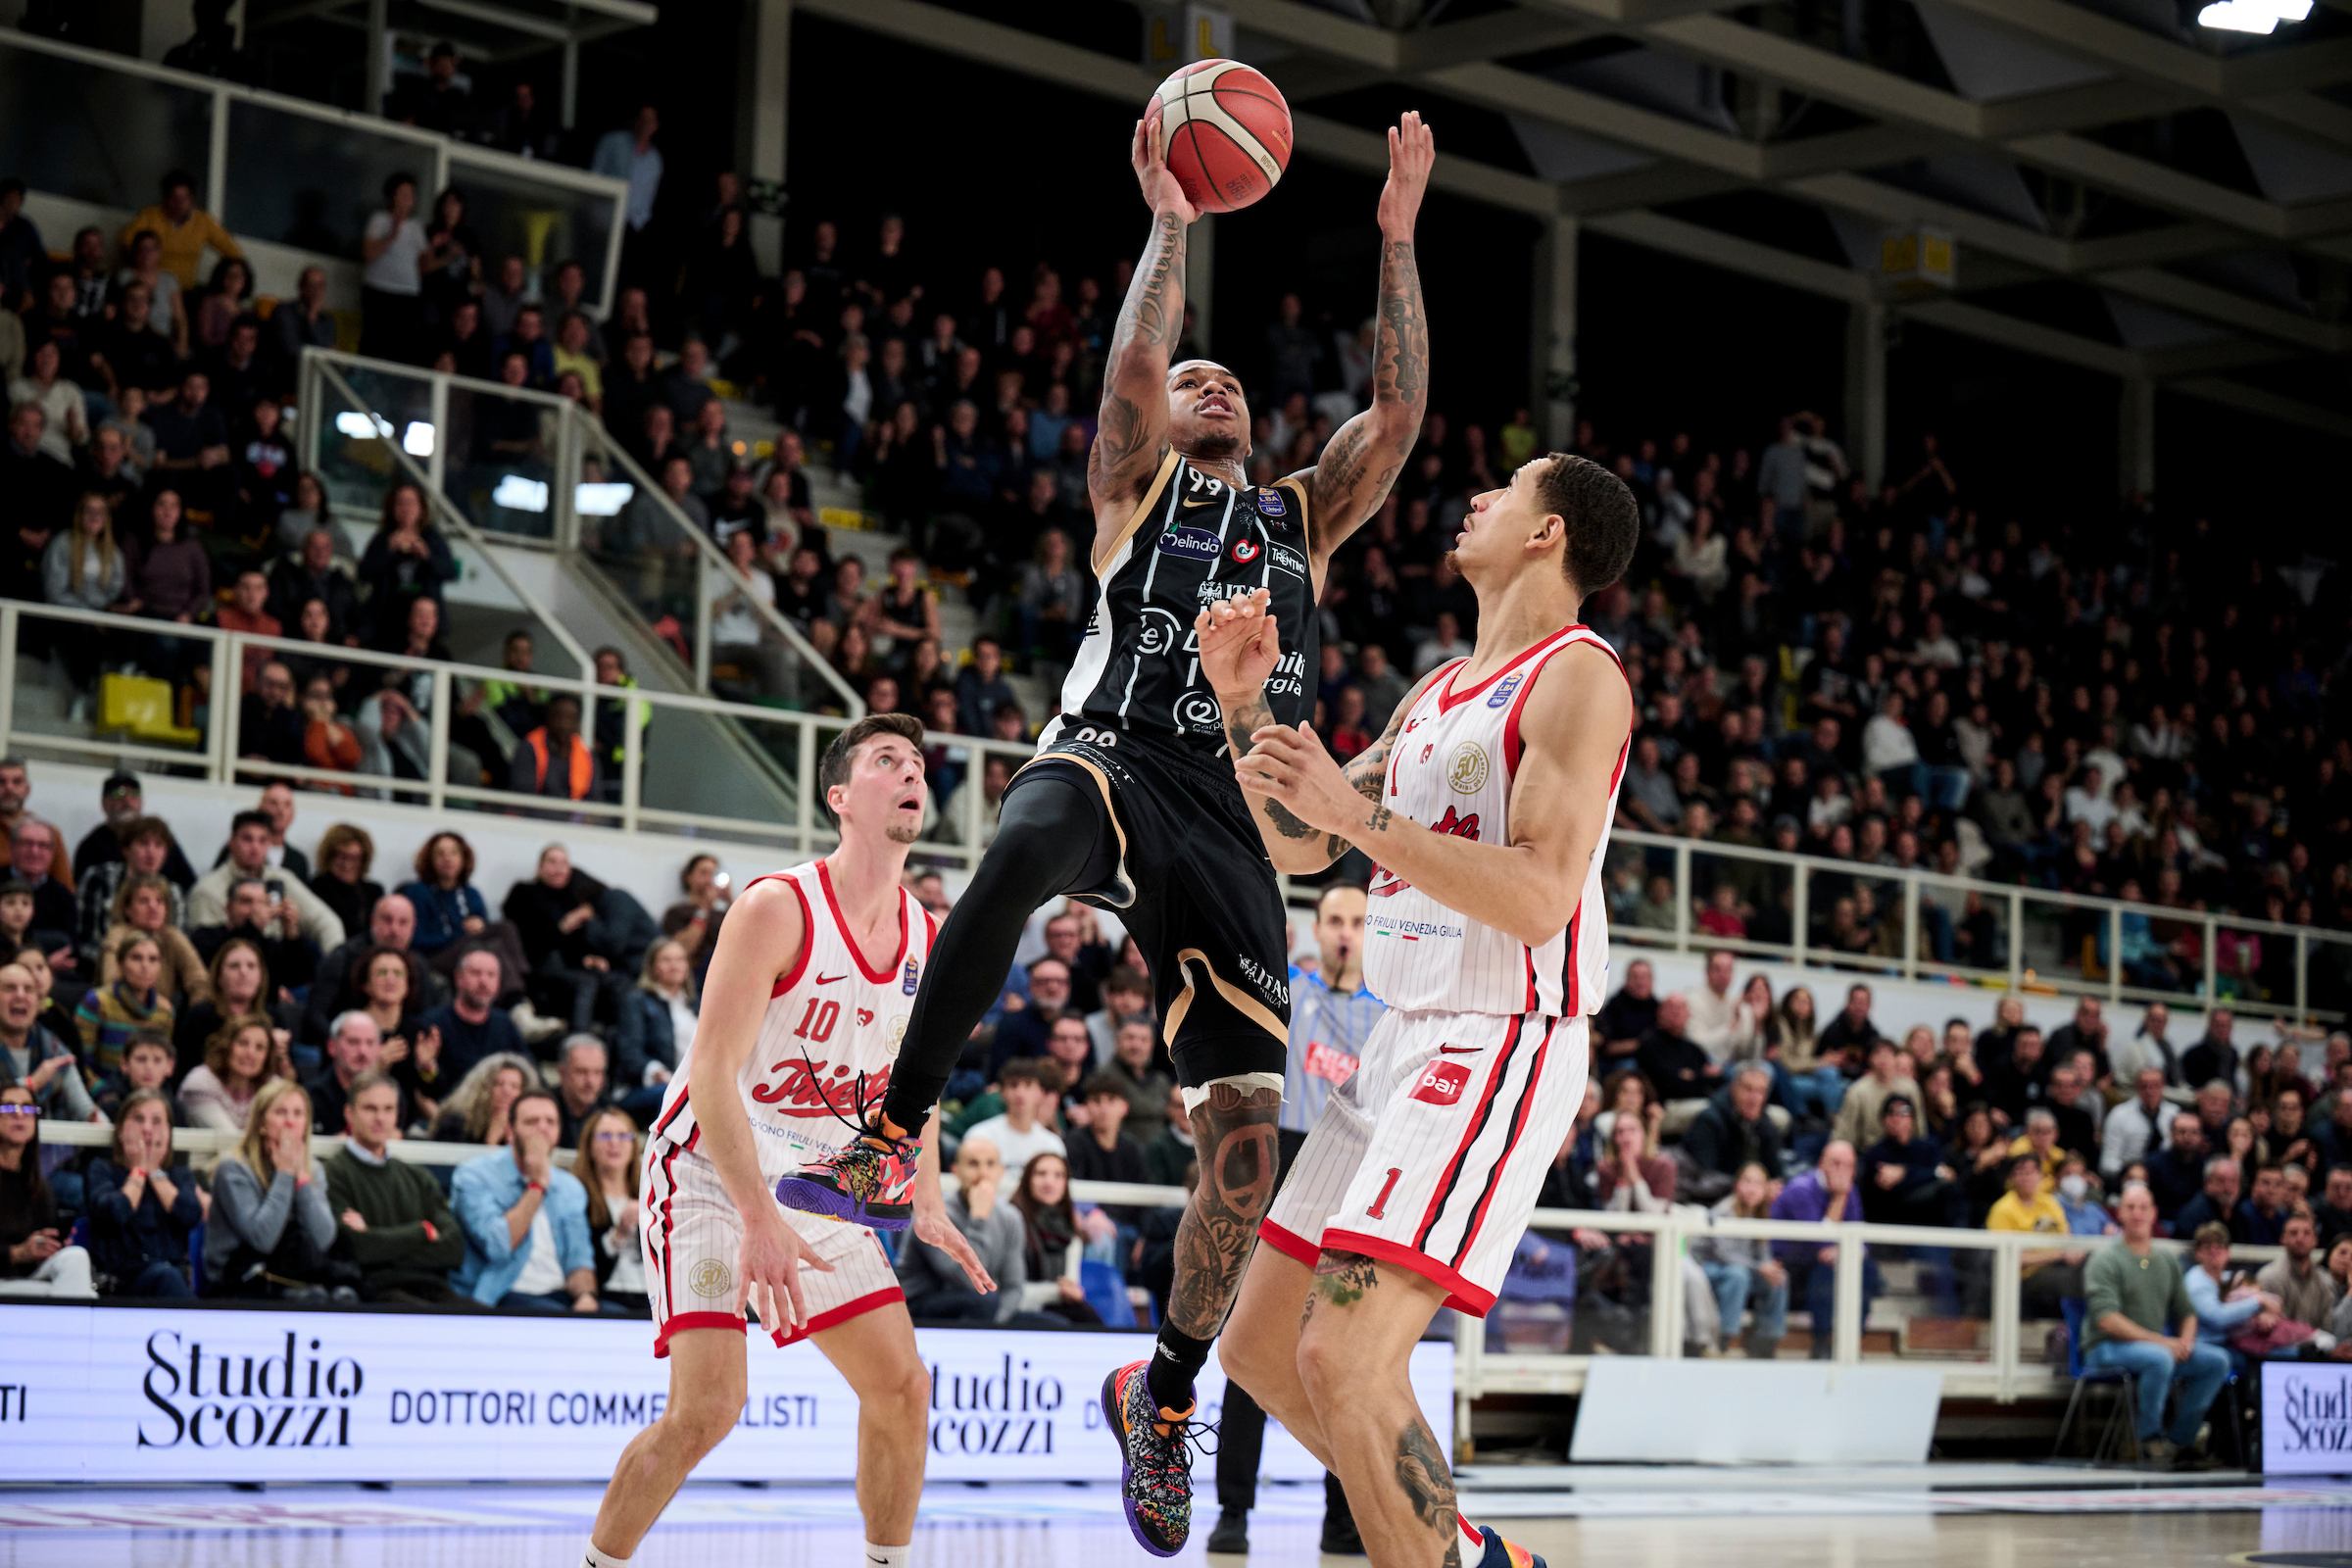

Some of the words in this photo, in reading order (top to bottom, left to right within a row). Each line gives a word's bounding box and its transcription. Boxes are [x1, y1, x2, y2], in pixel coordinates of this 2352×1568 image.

[1225, 177, 1249, 201] FIBA
[1188, 466, 1223, 497] 99
[1159, 530, 1220, 555] Melinda
[1262, 676, 1302, 698] rgia
[1454, 754, 1477, 780] 50
[1399, 919, 1438, 936] VENEZIA
[793, 997, 841, 1043] 10
[752, 1058, 891, 1109] Triest
[1422, 1071, 1459, 1096] bai
[787, 1130, 814, 1147] FRIULI
[1366, 1167, 1402, 1221] 1
[699, 1267, 721, 1288] 50
[144, 1329, 364, 1398] Studio
[931, 1351, 1063, 1412] tudio
[137, 1366, 352, 1449] Scozzi
[391, 1390, 536, 1426] DOTTORI
[548, 1391, 818, 1429] COMMELISTI
[2284, 1374, 2352, 1420] Stud
[931, 1403, 1055, 1454] cozzi
[2283, 1399, 2352, 1452] Scoz
